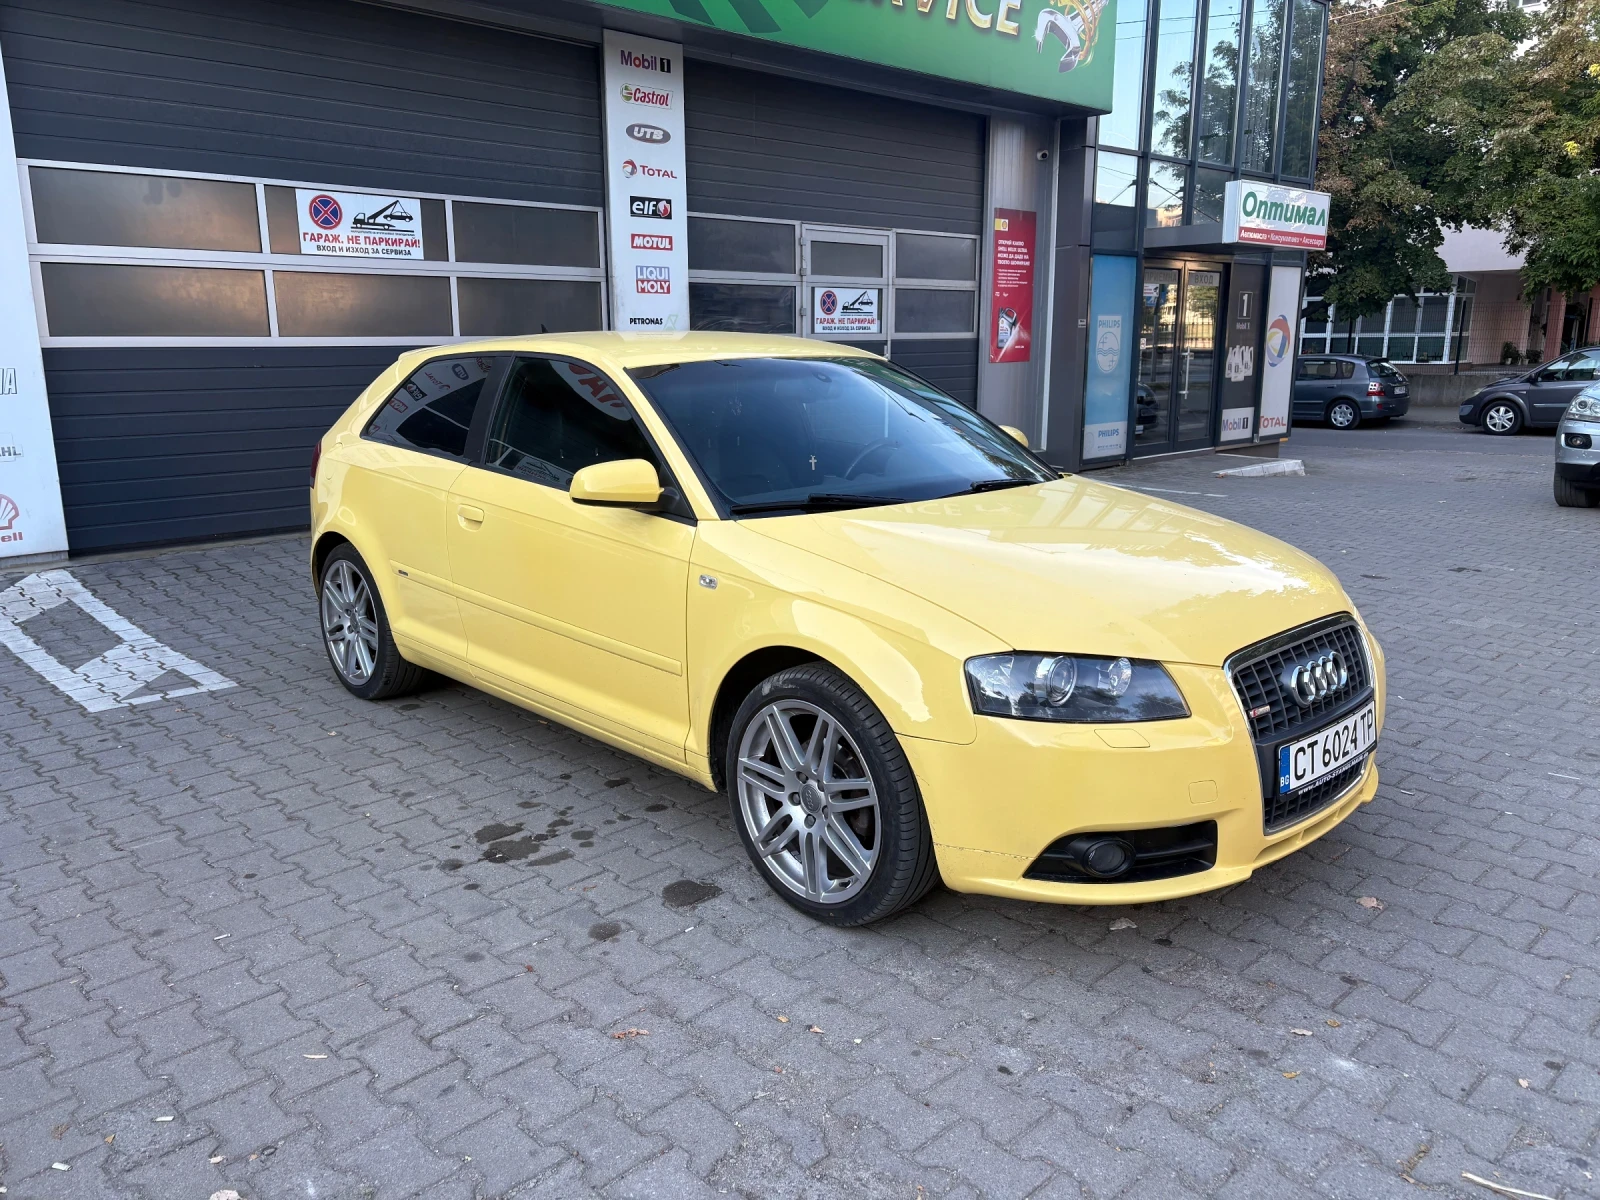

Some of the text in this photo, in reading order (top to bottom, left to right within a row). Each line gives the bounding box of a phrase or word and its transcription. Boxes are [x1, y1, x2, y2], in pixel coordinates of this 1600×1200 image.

[620, 50, 671, 74] Mobil 1
[633, 87, 669, 107] Castrol
[633, 126, 664, 140] UTB
[632, 200, 657, 216] elf
[1242, 191, 1326, 227] Оптимал
[302, 232, 344, 244] ГАРАЖ.
[347, 235, 361, 245] НЕ
[364, 236, 420, 249] ПАРКИРАЙ!
[633, 236, 671, 250] MOTUL
[316, 245, 337, 253] ВХОД
[345, 246, 369, 255] ИЗХОД
[371, 247, 380, 255] ЗА
[381, 248, 412, 256] СЕРВИЗА
[638, 267, 669, 281] LIQUI
[1194, 274, 1214, 285] ВХОД
[638, 280, 670, 293] MOLY
[629, 317, 663, 326] PETRONAS
[1098, 319, 1121, 328] PHILIPS
[1222, 417, 1241, 431] Mobil
[1098, 428, 1119, 438] PHILIPS
[0, 531, 23, 543] ell
[1294, 708, 1373, 781] CT 6024 TP
[1280, 775, 1289, 787] BG
